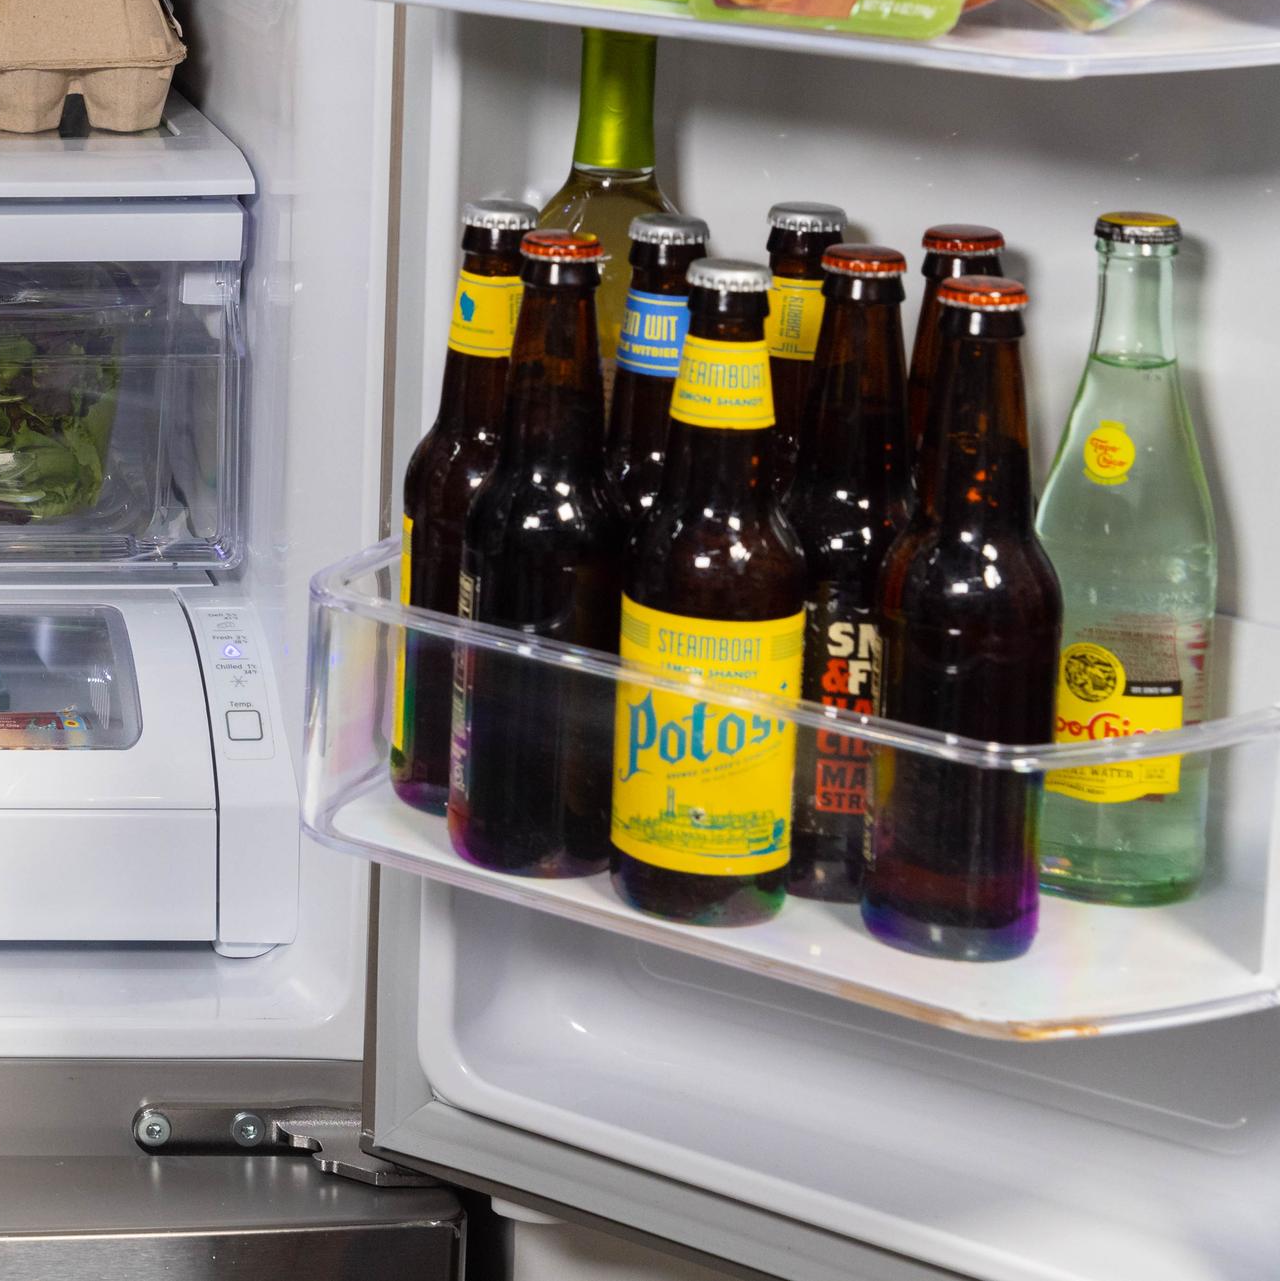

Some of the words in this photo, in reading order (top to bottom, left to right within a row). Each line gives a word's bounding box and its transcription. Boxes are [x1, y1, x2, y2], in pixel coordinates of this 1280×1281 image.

[632, 345, 679, 358] WITBIER
[657, 627, 763, 664] STEAMBOAT
[1091, 769, 1134, 779] WATER
